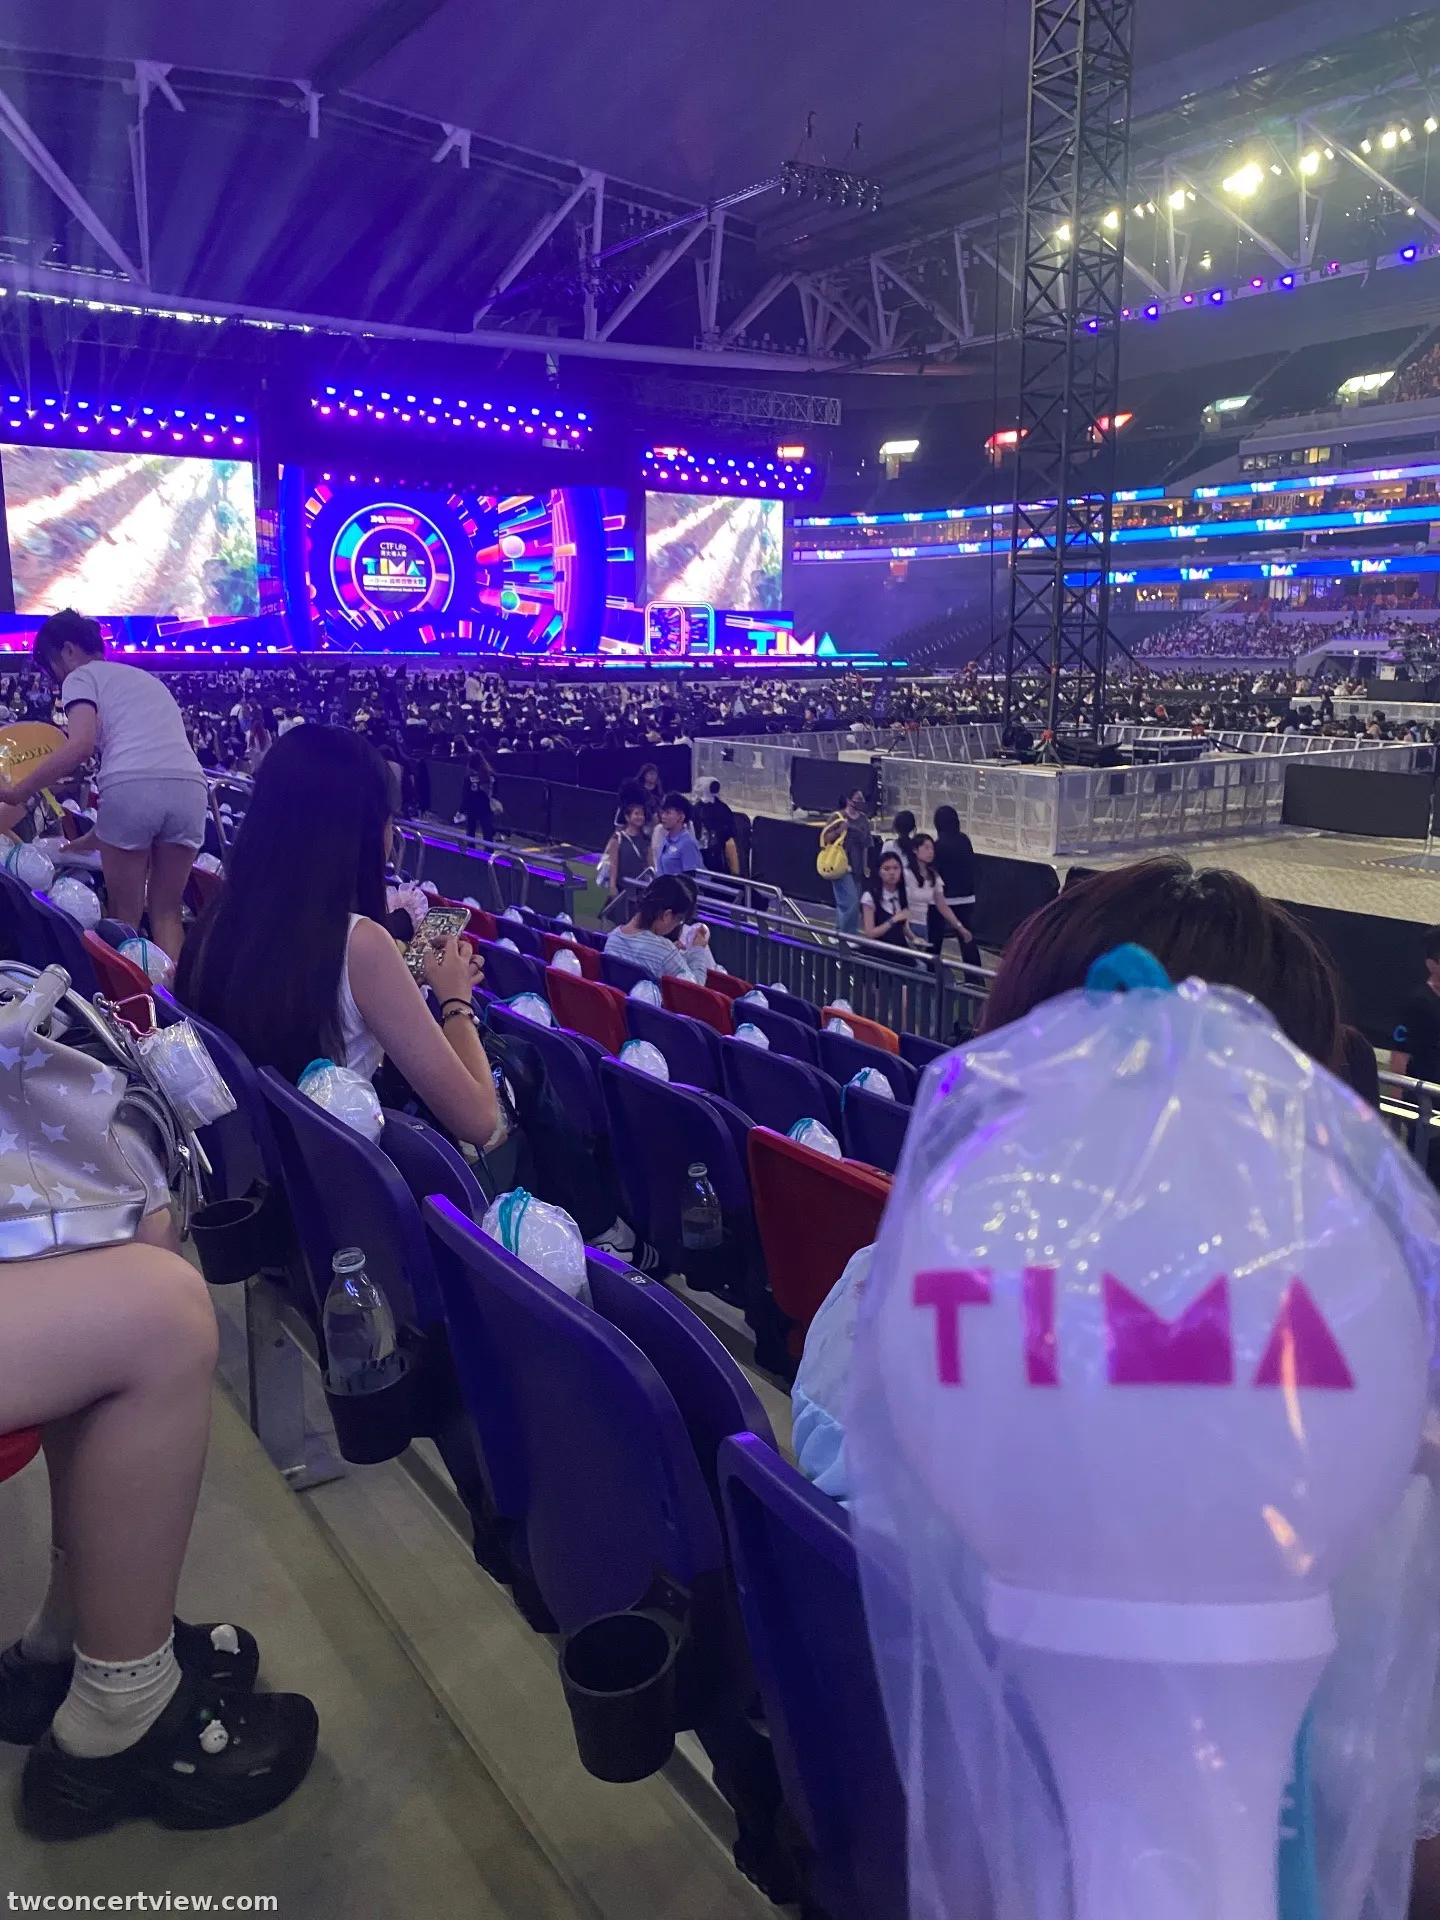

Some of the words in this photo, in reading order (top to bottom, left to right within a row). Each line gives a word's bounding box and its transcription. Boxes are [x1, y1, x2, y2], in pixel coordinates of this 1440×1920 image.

[362, 557, 421, 576] TIMA
[748, 631, 837, 655] TIMA
[913, 1266, 1356, 1389] TIMA
